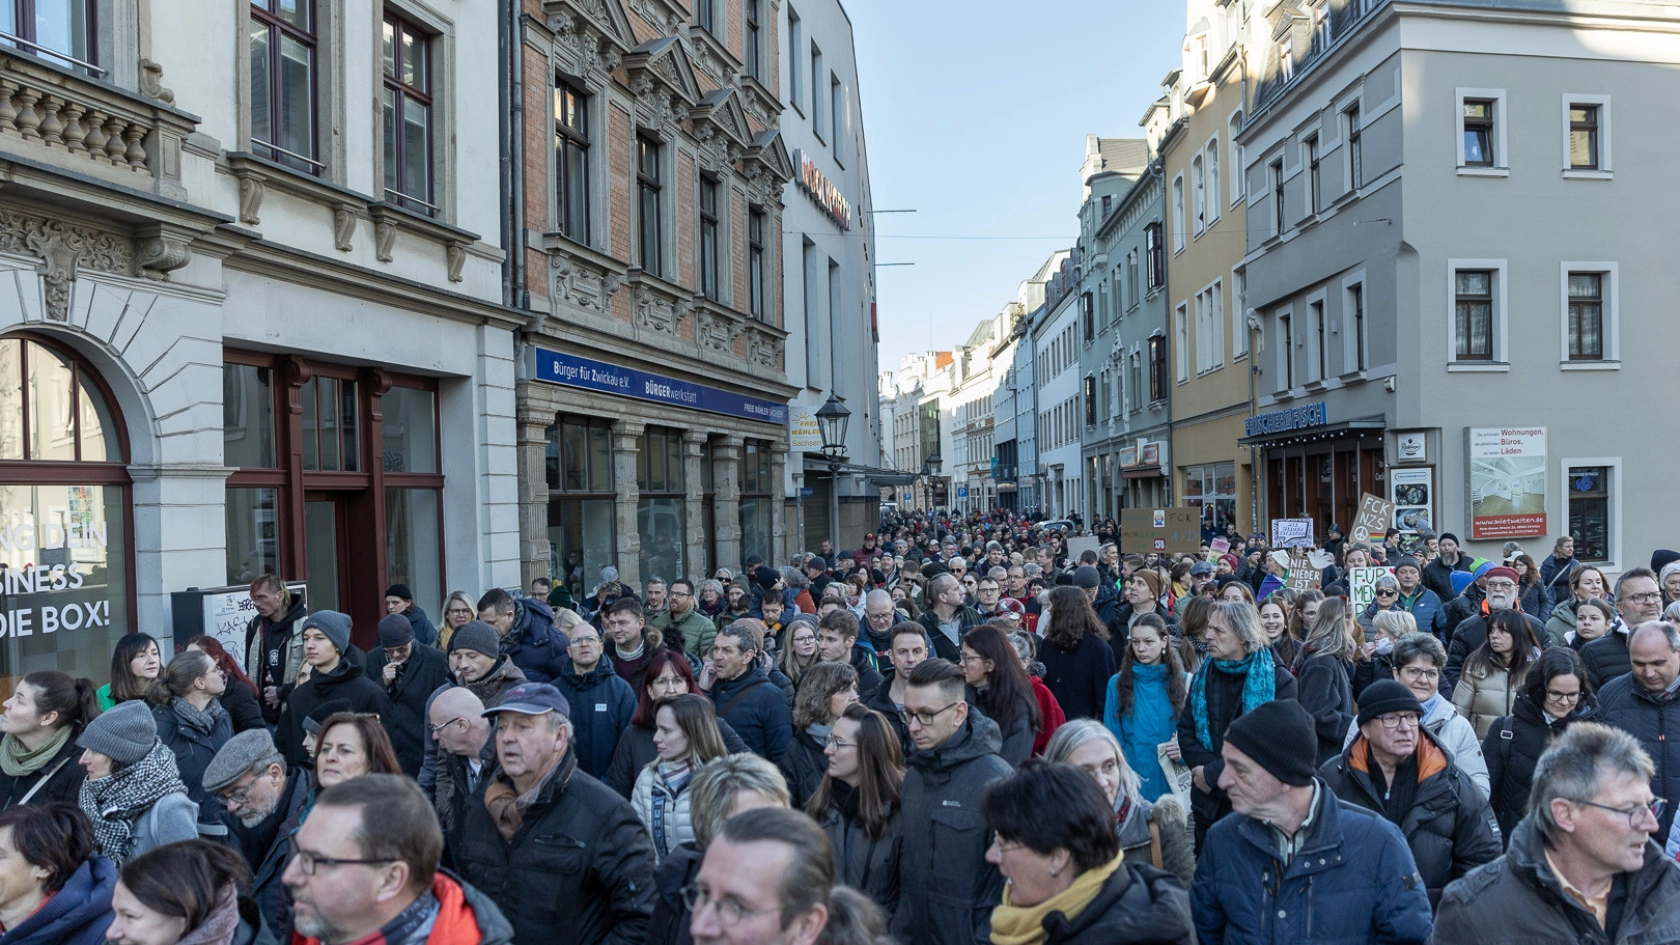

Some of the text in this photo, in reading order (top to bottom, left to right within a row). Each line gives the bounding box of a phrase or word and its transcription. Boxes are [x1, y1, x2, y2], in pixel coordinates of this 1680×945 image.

[553, 361, 630, 388] Bürger für Zwickau e.V.
[645, 379, 697, 403] BÜRGERwerkstatt
[744, 403, 755, 413] FREIE
[755, 405, 769, 416] WÄHLER
[1501, 429, 1543, 437] Wohnungen,
[1364, 497, 1390, 516] FCK
[1169, 513, 1192, 522] FCK
[1359, 512, 1385, 530] NZS
[45, 521, 108, 550] DEIN
[1172, 529, 1198, 542] AFD
[1290, 558, 1308, 569] NIE
[1289, 568, 1320, 581] WIEDER
[1354, 568, 1386, 585] FÜR
[1295, 579, 1310, 590] IST
[41, 600, 110, 634] BOX!
